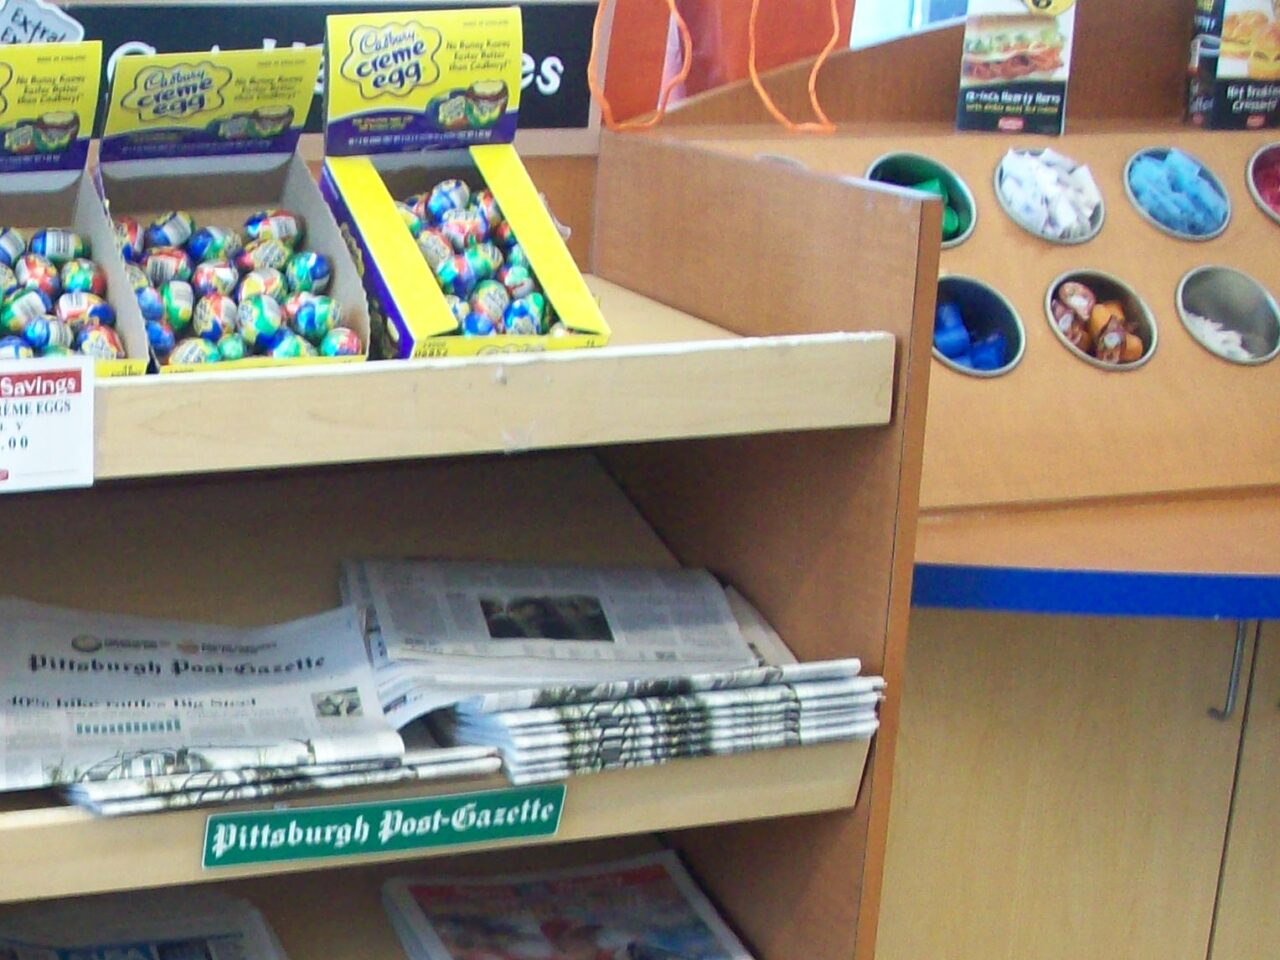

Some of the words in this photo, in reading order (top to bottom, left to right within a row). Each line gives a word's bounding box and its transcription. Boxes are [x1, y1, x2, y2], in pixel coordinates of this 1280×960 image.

[360, 29, 416, 55] Cadbury
[356, 40, 426, 78] creme
[144, 68, 204, 91] Cadbury
[373, 62, 421, 89] egg
[137, 78, 213, 107] creme
[153, 94, 205, 115] egg
[0, 375, 76, 398] Savings
[36, 401, 72, 414] EGGS
[29, 653, 162, 677] Pittsburgh
[172, 655, 326, 675] Post-Gazette
[211, 815, 370, 860] Pittsburgh
[378, 797, 555, 846] Post-Gazette
